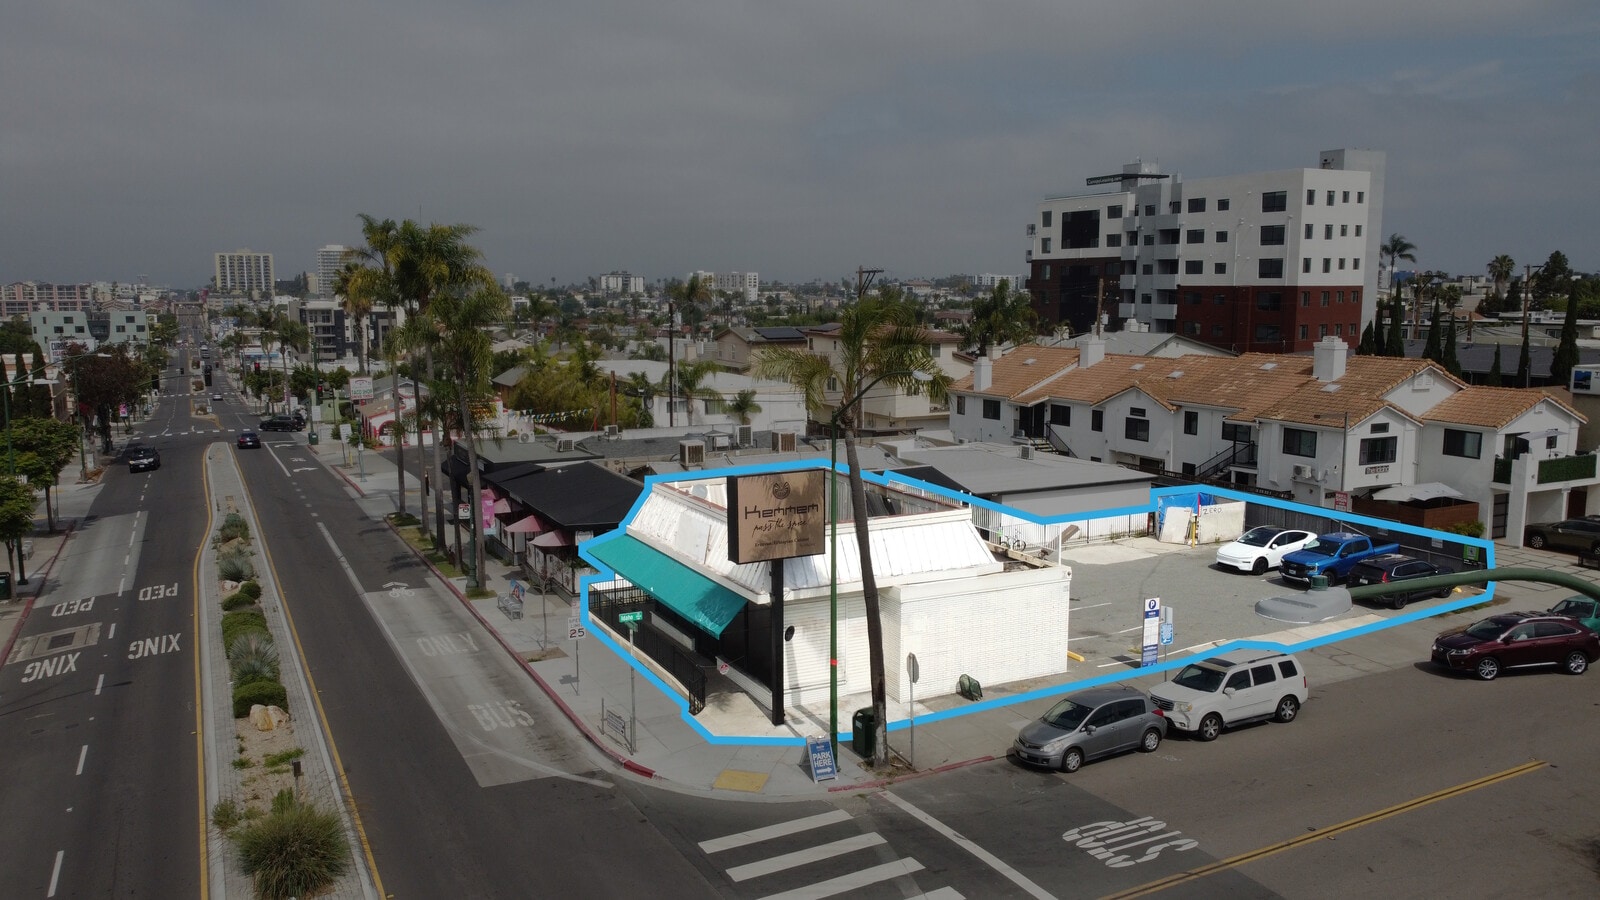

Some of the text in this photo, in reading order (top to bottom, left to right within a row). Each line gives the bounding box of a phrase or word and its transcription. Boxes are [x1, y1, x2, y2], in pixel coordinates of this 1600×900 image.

[751, 523, 772, 539] pass
[768, 517, 784, 530] the
[138, 582, 179, 601] PED
[51, 596, 95, 617] PED
[569, 628, 585, 639] 25
[127, 632, 182, 660] XING
[416, 633, 480, 657] ONLY
[20, 651, 81, 683] XING
[467, 700, 534, 732] BUS
[812, 751, 831, 761] PARK
[814, 759, 833, 768] HERE
